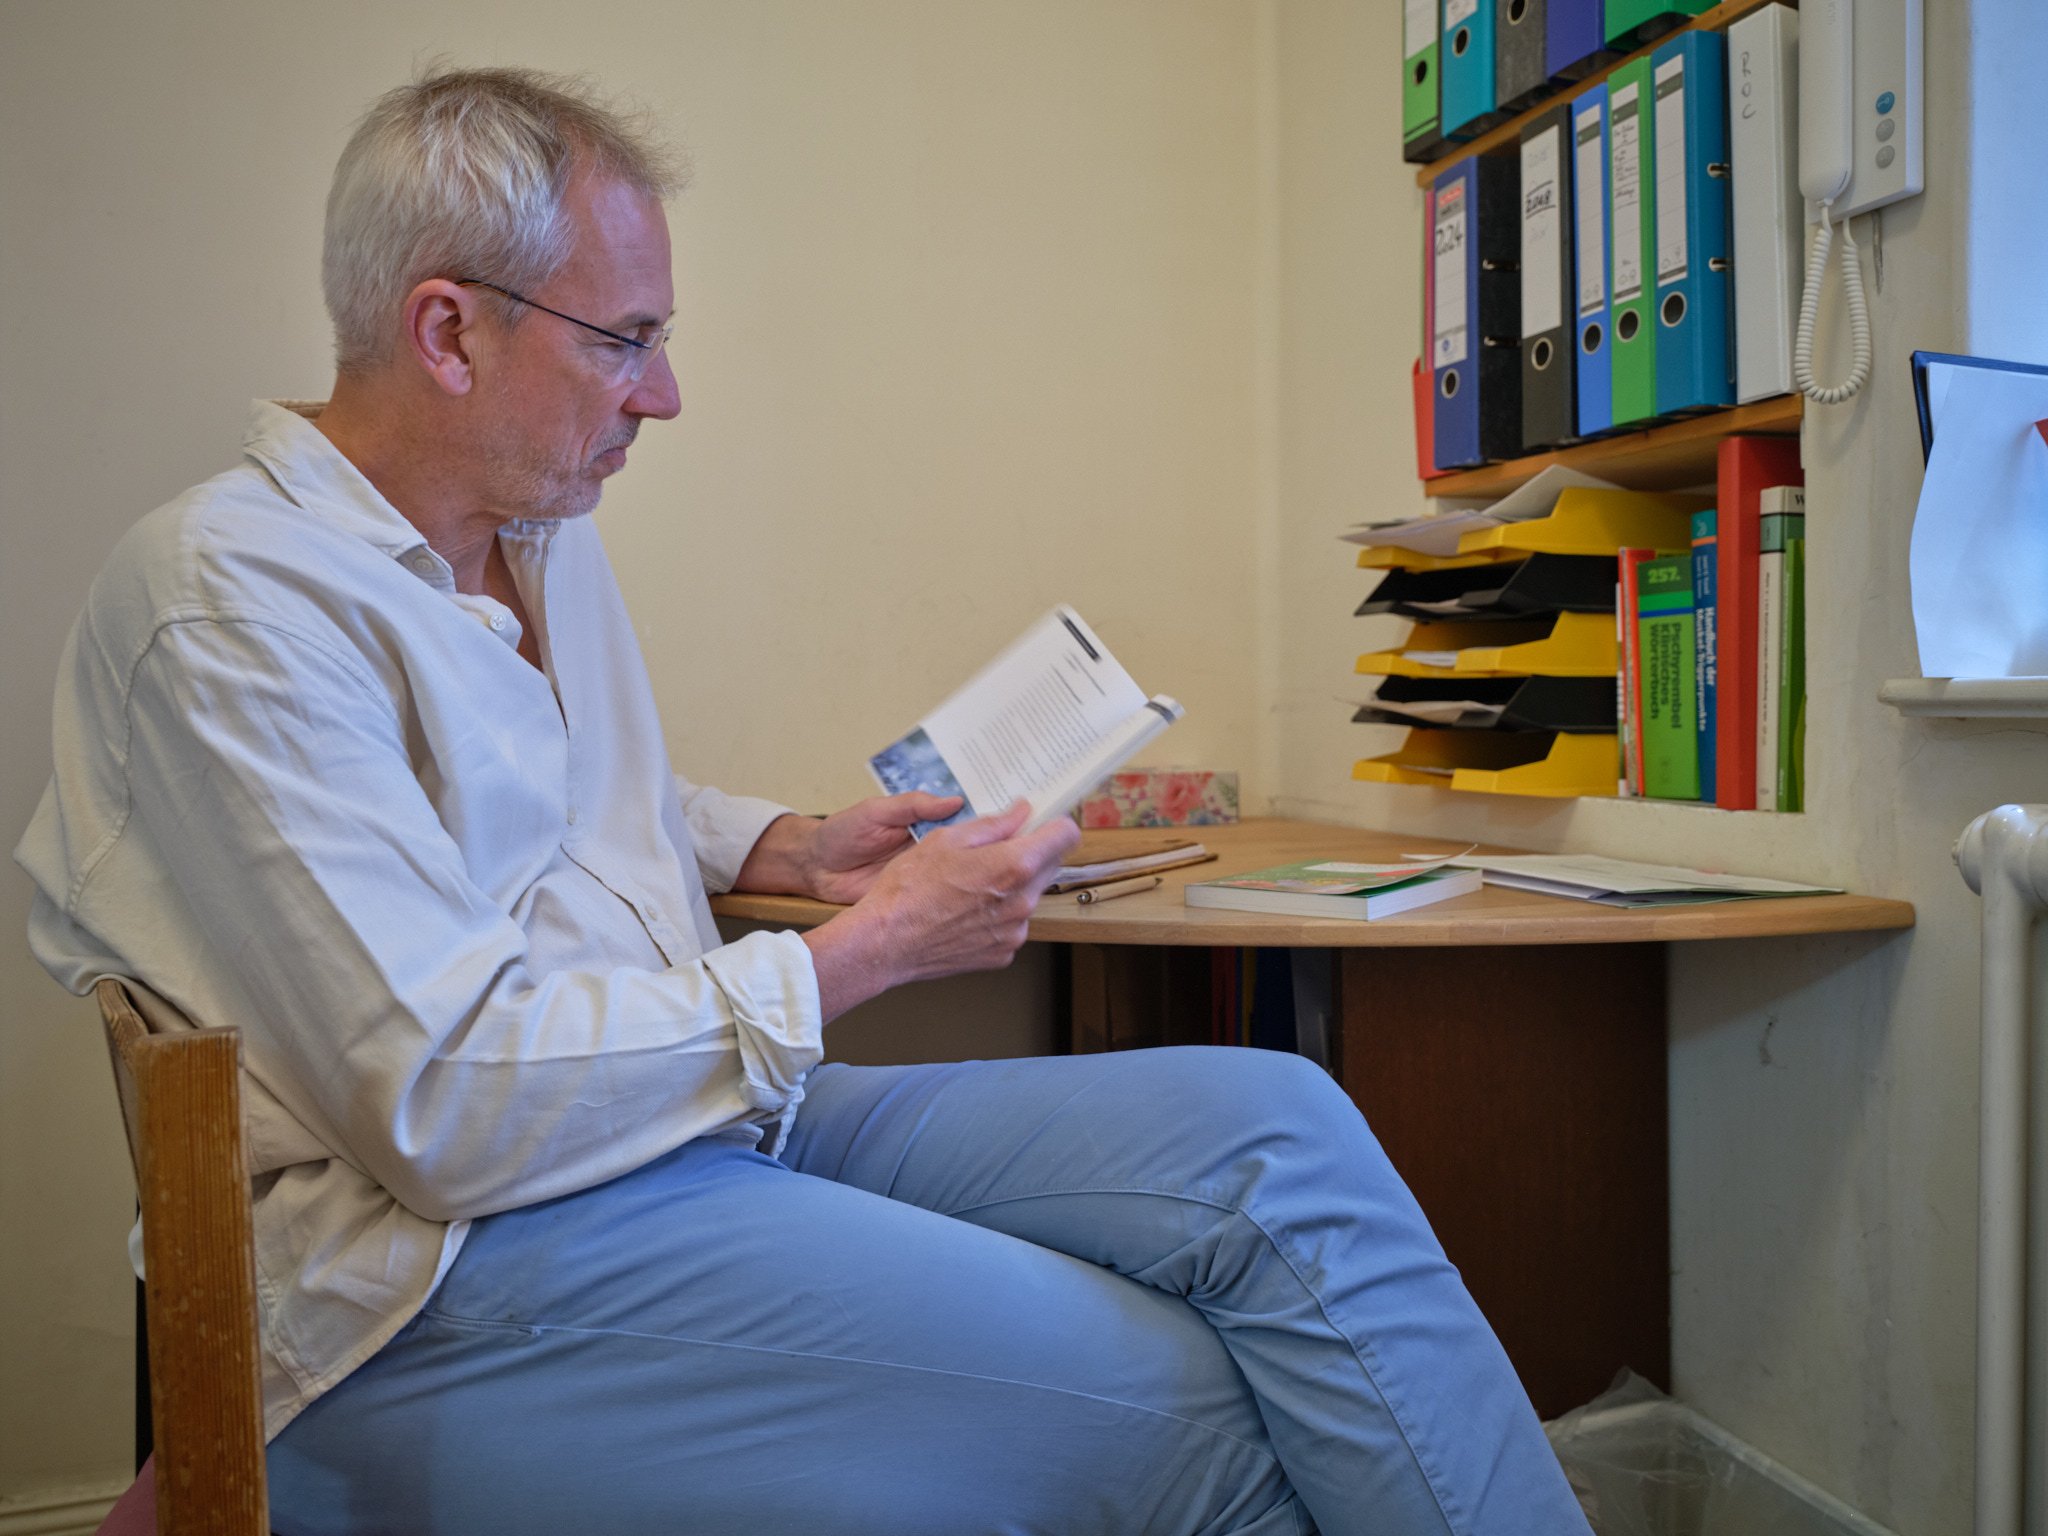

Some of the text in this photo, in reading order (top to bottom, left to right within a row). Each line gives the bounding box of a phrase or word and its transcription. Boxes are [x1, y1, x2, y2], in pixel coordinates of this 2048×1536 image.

[1648, 566, 1680, 583] 257.
[1705, 607, 1716, 662] Handbuch
[1660, 623, 1670, 706] Klinisches
[1670, 622, 1682, 728] Pschyrembel
[1706, 665, 1717, 685] der
